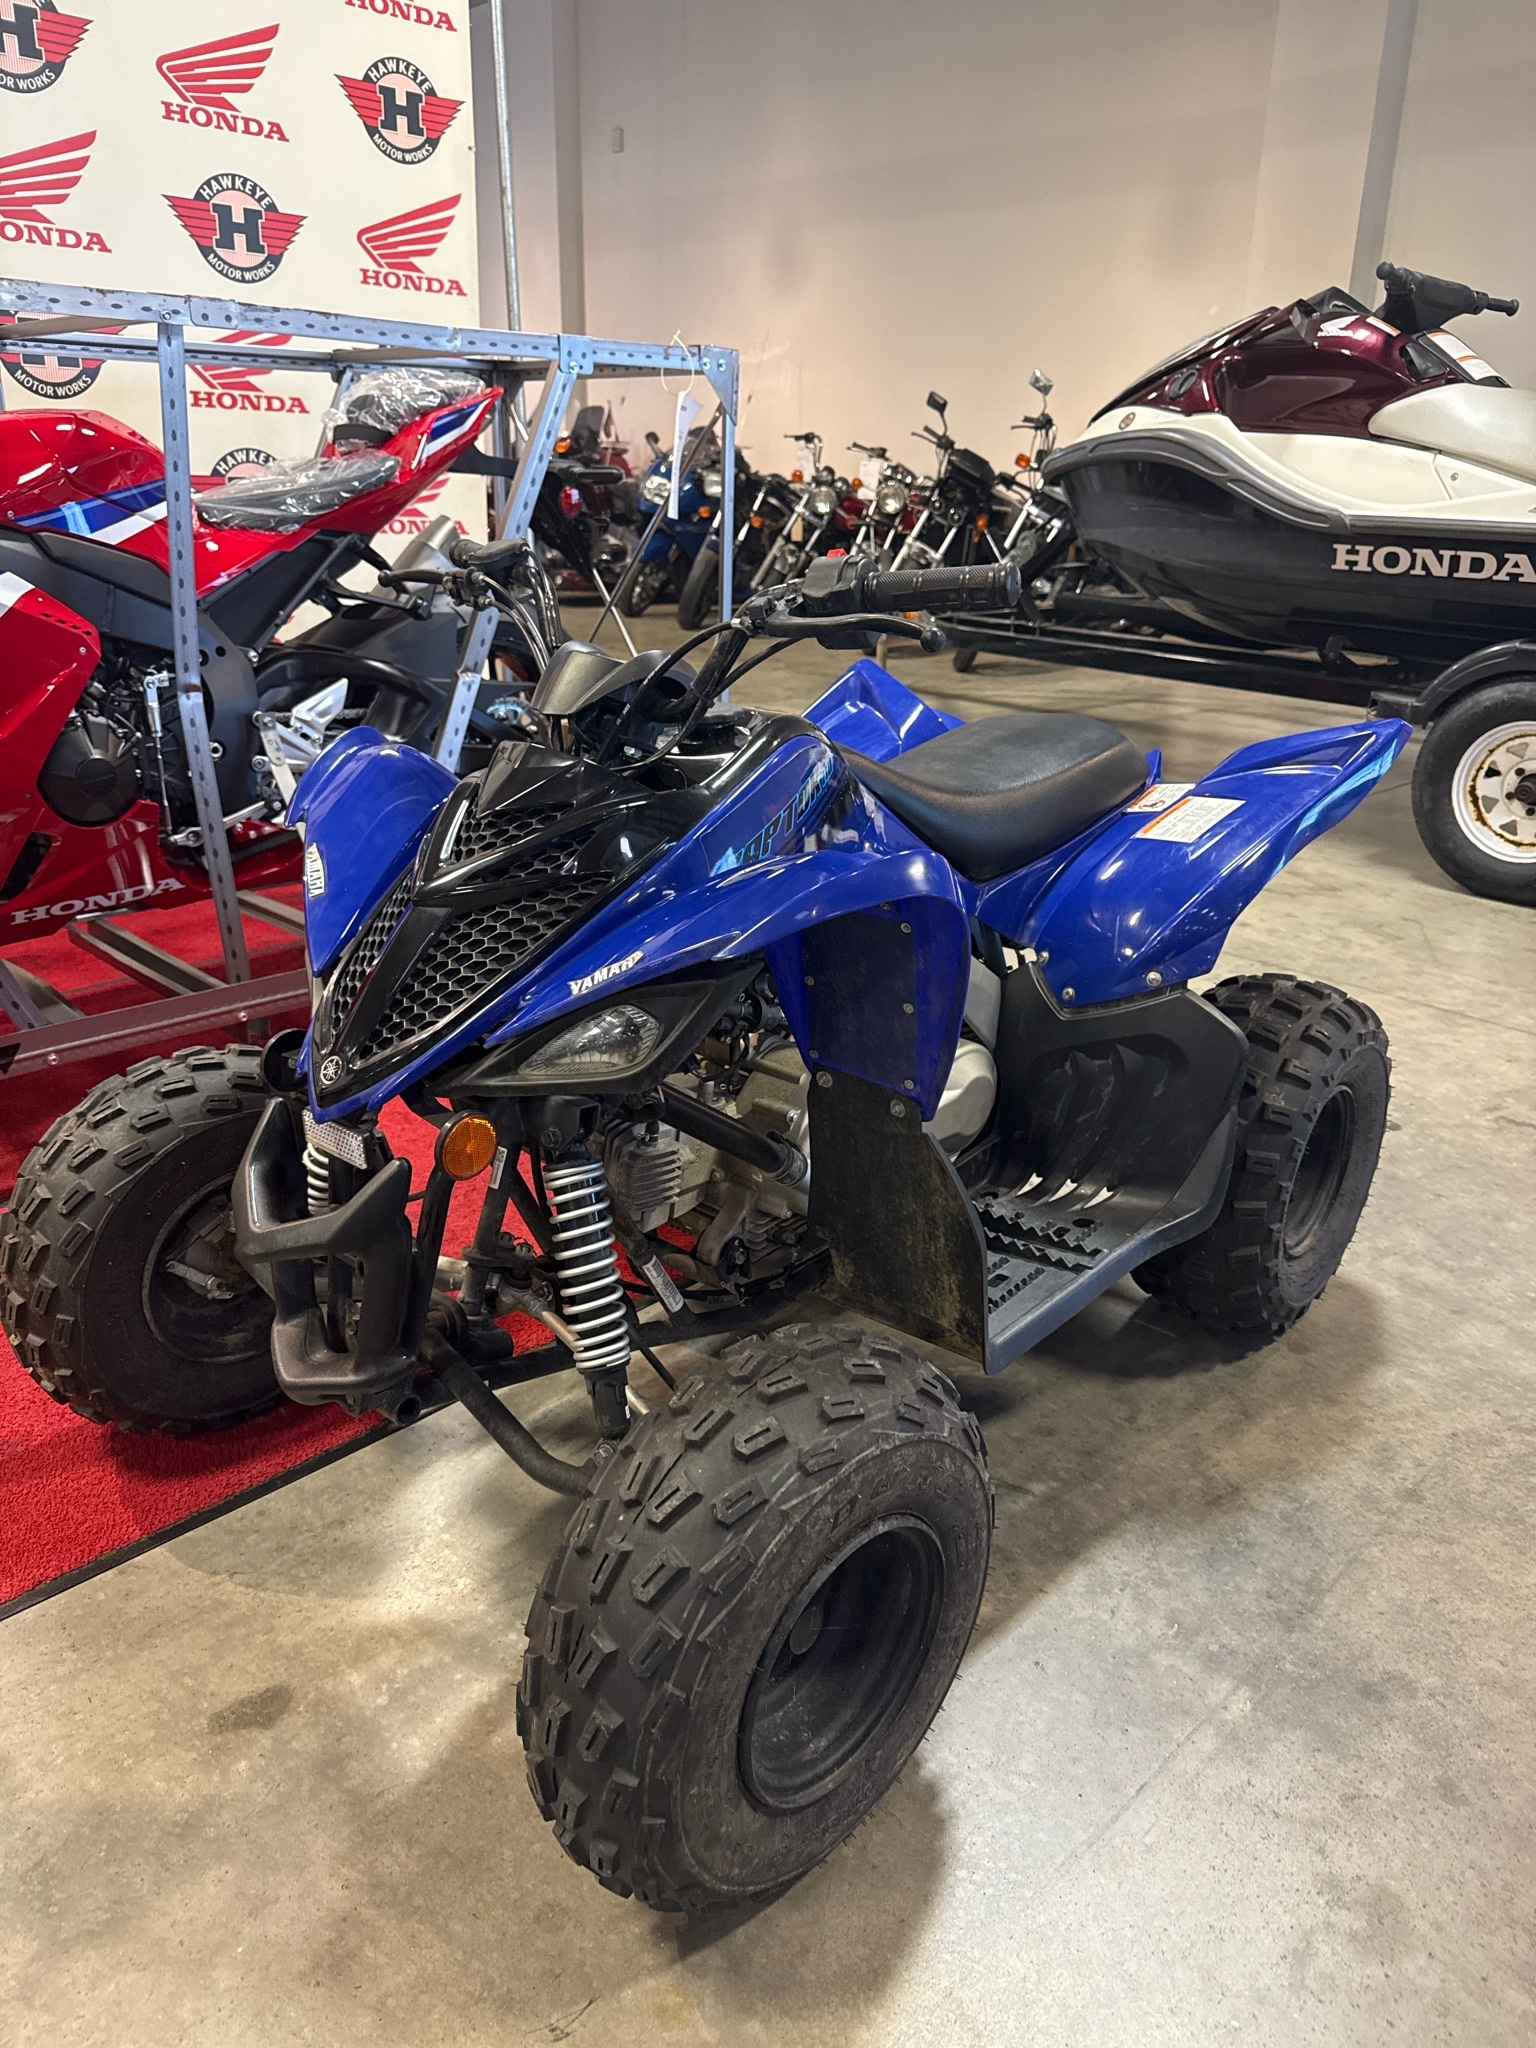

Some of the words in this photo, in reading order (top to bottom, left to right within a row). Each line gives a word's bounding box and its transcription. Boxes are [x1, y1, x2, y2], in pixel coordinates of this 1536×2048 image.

[16, 69, 55, 90] WORKS
[367, 59, 432, 93] HAWKEYE
[161, 100, 290, 142] HONDA
[378, 84, 425, 137] H
[372, 133, 403, 161] MOTOR
[404, 143, 433, 162] WORKS
[200, 175, 272, 209] HAWKEYE
[212, 202, 266, 254] H
[207, 253, 242, 280] MOTOR
[243, 260, 276, 281] WORKS
[359, 268, 468, 297] HONDA
[14, 369, 54, 396] MOTOR
[55, 374, 92, 397] WORKS
[189, 390, 310, 414] HONDA
[215, 449, 277, 475] HAWKEY
[380, 520, 469, 535] ONA
[1331, 543, 1536, 583] HONDA
[10, 877, 186, 925] HONDA
